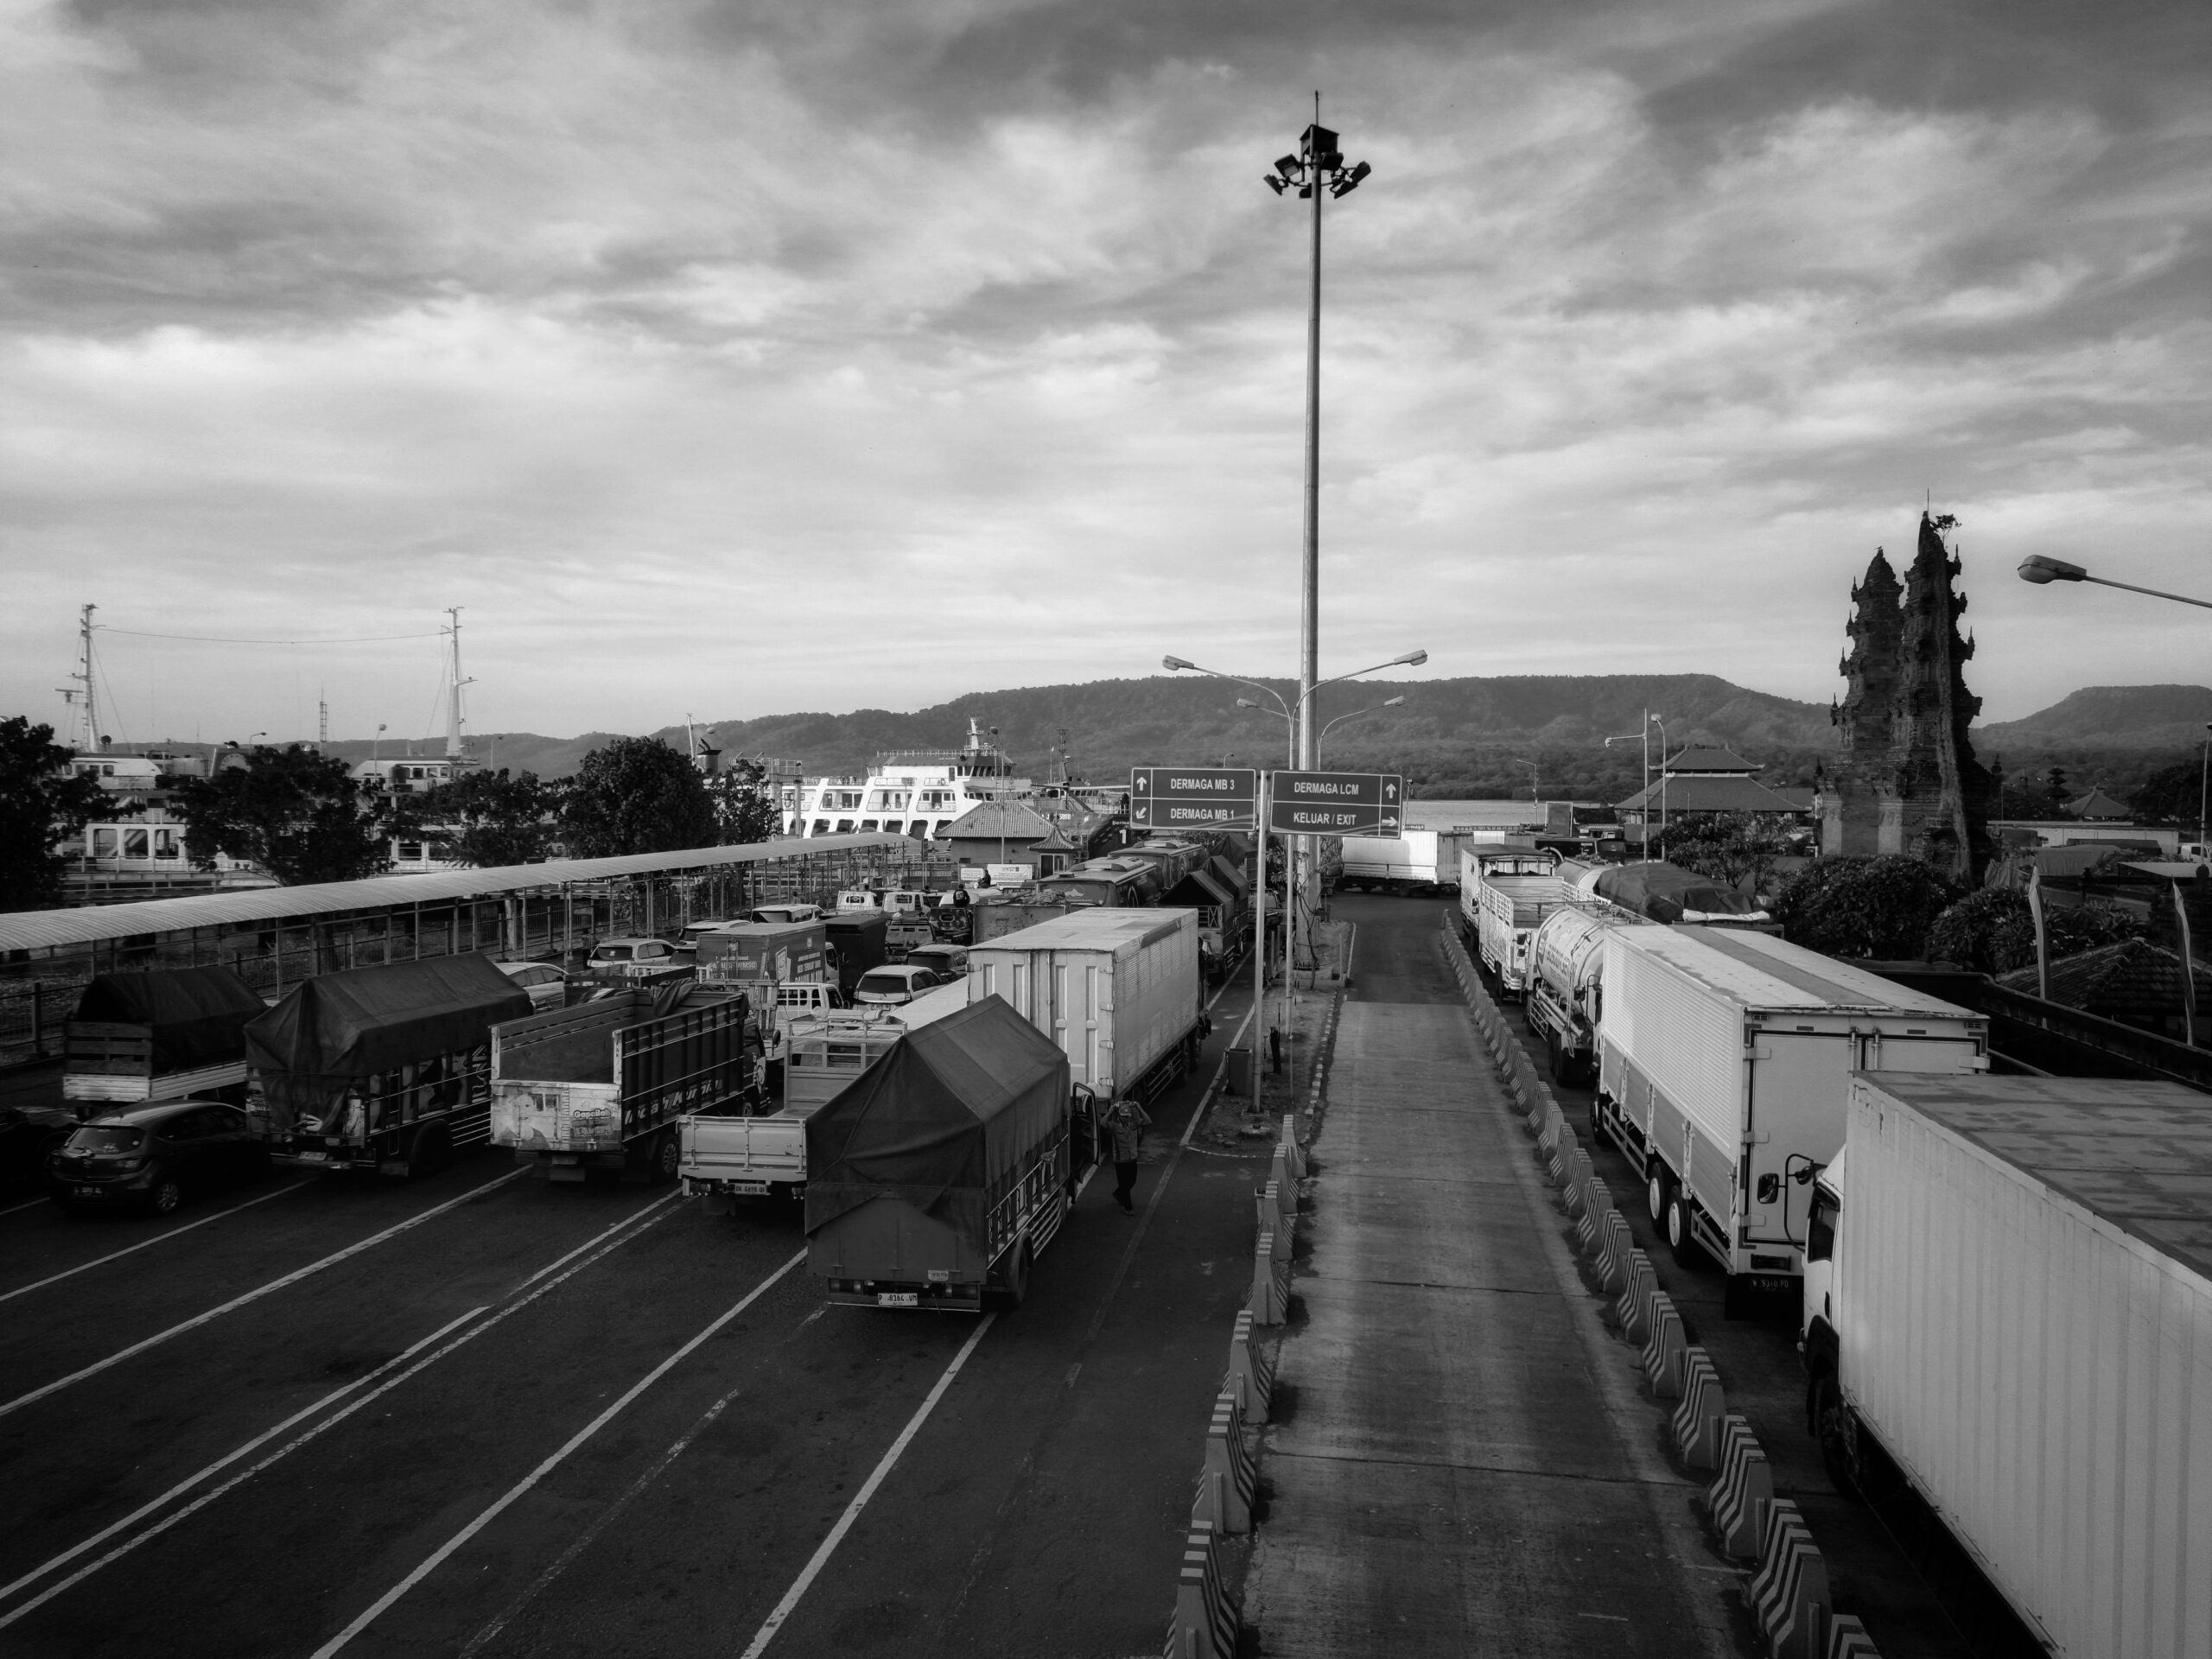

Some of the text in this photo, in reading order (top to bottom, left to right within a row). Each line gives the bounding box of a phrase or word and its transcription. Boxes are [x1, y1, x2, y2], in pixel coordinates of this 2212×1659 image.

[1170, 779, 1235, 790] DERMAGA MB 3
[1294, 782, 1359, 795] DERMAGA LCM
[1170, 808, 1234, 820] DERMAGA MB 1
[1294, 812, 1330, 824] KELUAR
[1337, 814, 1357, 825] EXIT
[1119, 830, 1127, 844] 1
